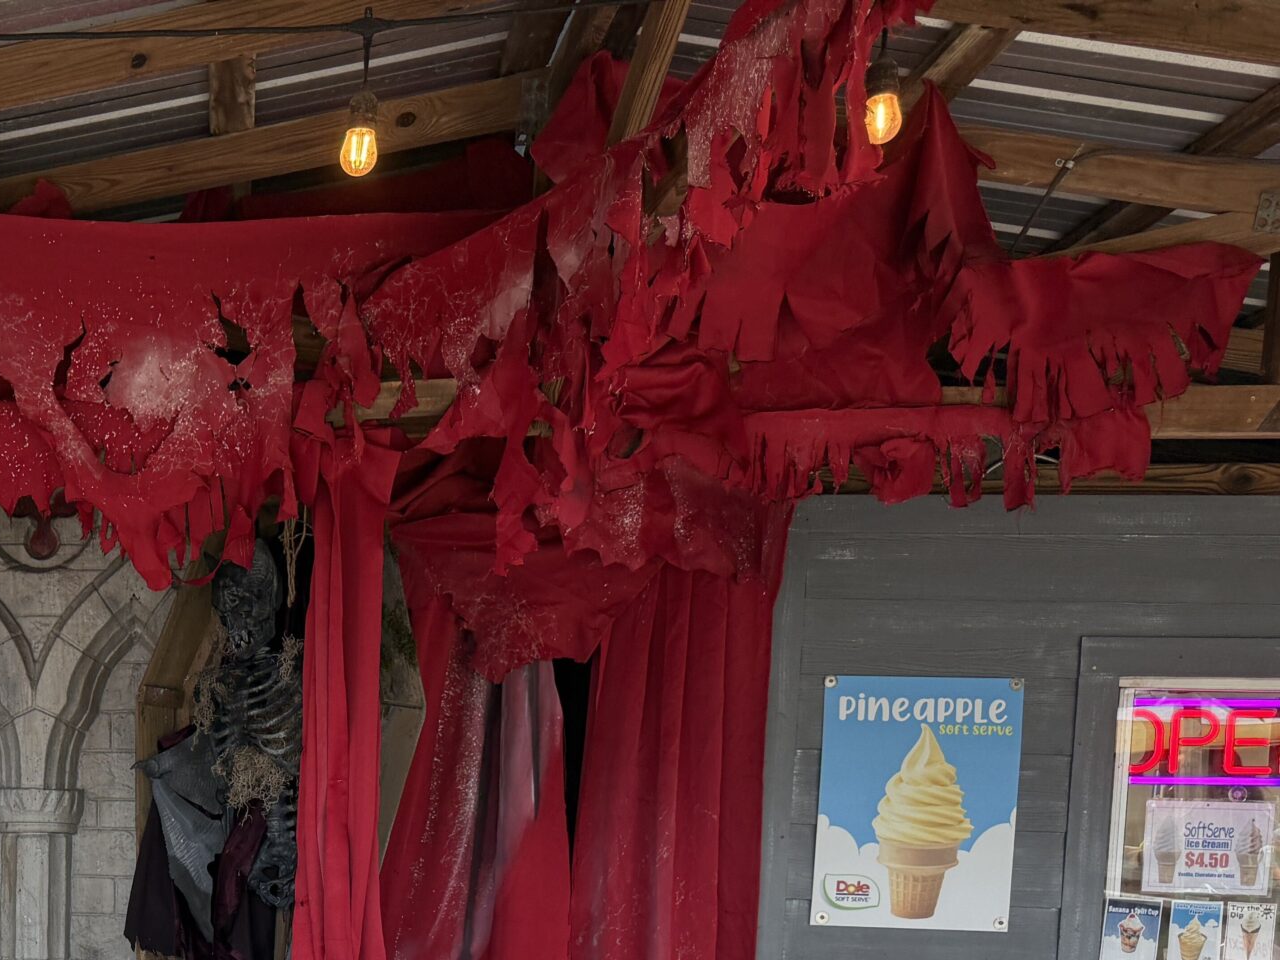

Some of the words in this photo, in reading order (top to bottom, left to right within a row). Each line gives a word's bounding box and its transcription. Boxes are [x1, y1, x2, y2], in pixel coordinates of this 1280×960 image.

[939, 723, 969, 735] soft
[972, 724, 1013, 736] serve
[1128, 708, 1280, 775] OPE
[1186, 840, 1200, 849] Ice
[1201, 840, 1229, 849] Cream
[1185, 851, 1230, 868] $4.50
[835, 880, 870, 893] Dole
[1108, 905, 1130, 914] Banana
[1147, 907, 1159, 916] Cup
[1230, 904, 1245, 912] Try
[1246, 904, 1260, 912] the
[1230, 912, 1244, 920] Dip
